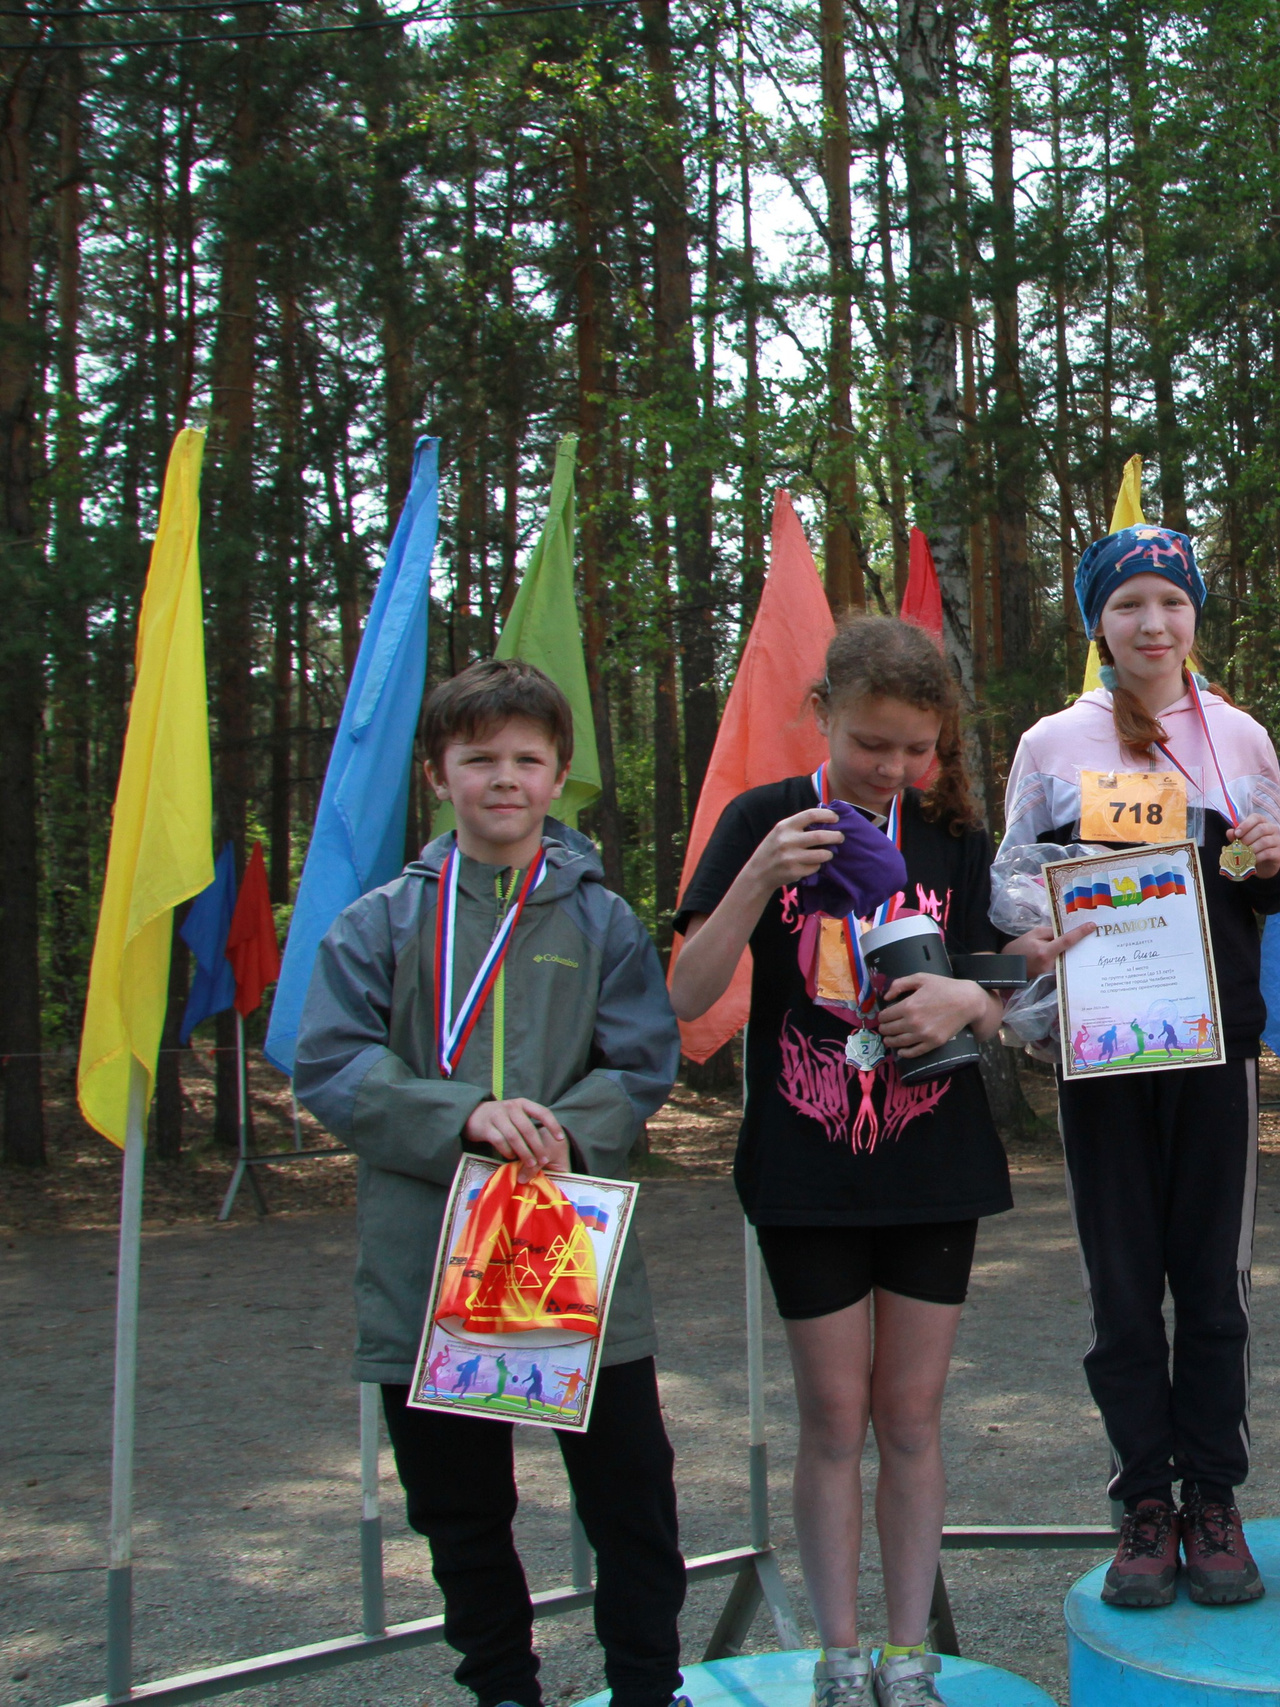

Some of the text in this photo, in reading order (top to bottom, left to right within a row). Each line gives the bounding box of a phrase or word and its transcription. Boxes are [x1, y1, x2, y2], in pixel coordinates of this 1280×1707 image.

[1109, 801, 1163, 825] 718
[1235, 856, 1240, 865] 1
[1095, 916, 1167, 937] ГРАМОТА
[1134, 950, 1160, 959] Ольга
[1139, 982, 1178, 990] ориентированию
[862, 1045, 869, 1054] 2
